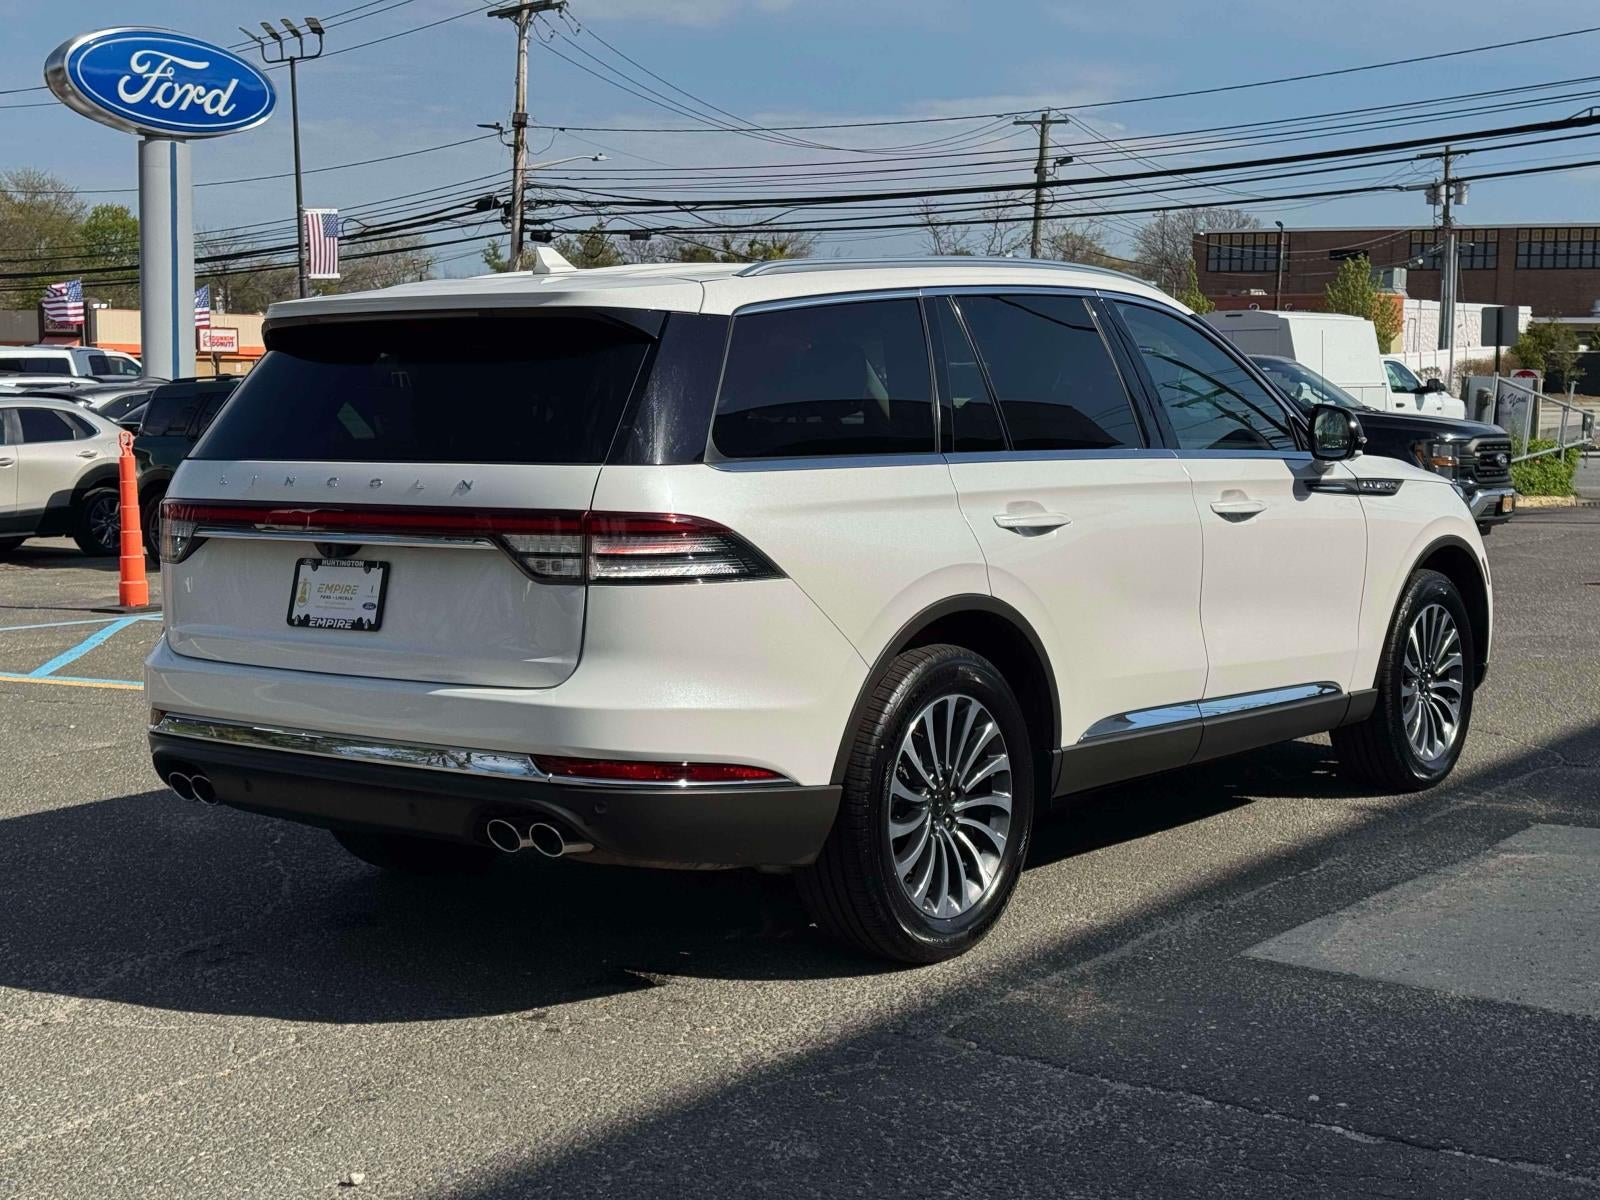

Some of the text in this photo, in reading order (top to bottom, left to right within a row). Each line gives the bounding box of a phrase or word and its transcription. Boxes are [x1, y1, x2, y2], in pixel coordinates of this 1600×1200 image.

[118, 49, 239, 117] Ford
[219, 473, 474, 492] LINCOLN
[321, 559, 365, 568] HUNTINGTON
[317, 583, 360, 595] EMPIRE
[308, 617, 353, 629] EMPIRE
